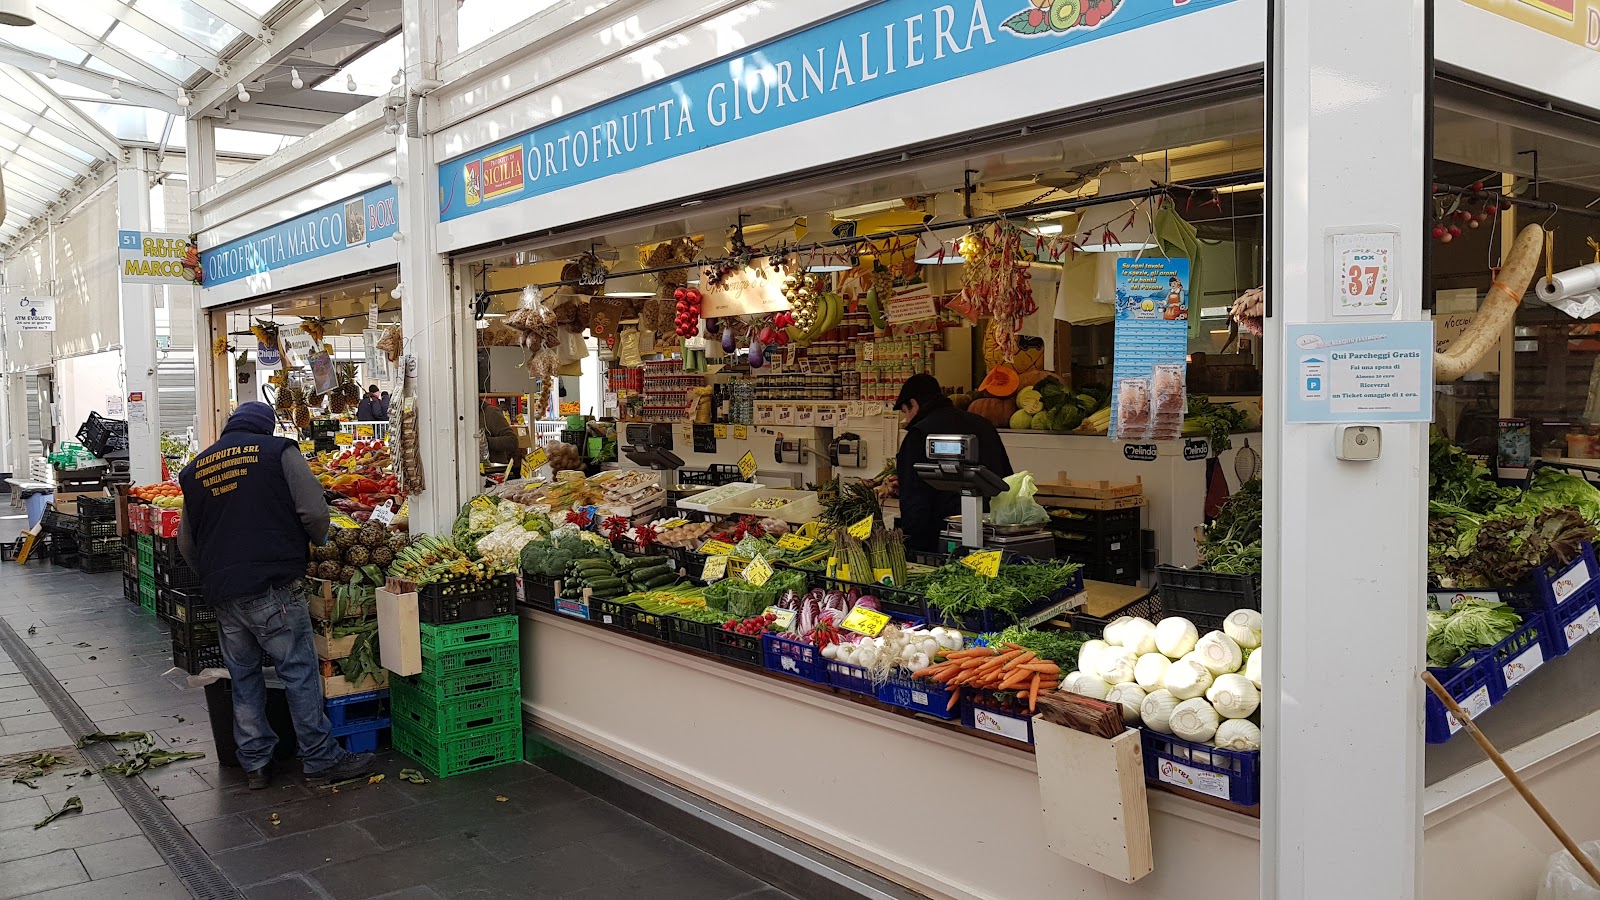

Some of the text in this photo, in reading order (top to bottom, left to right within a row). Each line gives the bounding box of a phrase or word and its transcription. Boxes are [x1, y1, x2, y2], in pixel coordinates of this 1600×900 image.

[527, 0, 996, 182] ORTOFRUTTA GIORNALIERA
[484, 160, 522, 187] SICILIA
[368, 196, 396, 232] BOX
[123, 235, 136, 245] 51
[142, 237, 187, 248] ORTO
[143, 246, 188, 258] FRUTTA
[209, 212, 343, 281] ORTOFRUTTA MARCO
[125, 259, 184, 277] MARCO
[1348, 265, 1380, 296] 37
[1331, 351, 1420, 360] Qui Parcheggi Gratis
[243, 445, 260, 453] SRL
[1124, 446, 1156, 456] Melinda
[1184, 445, 1208, 456] Melinda
